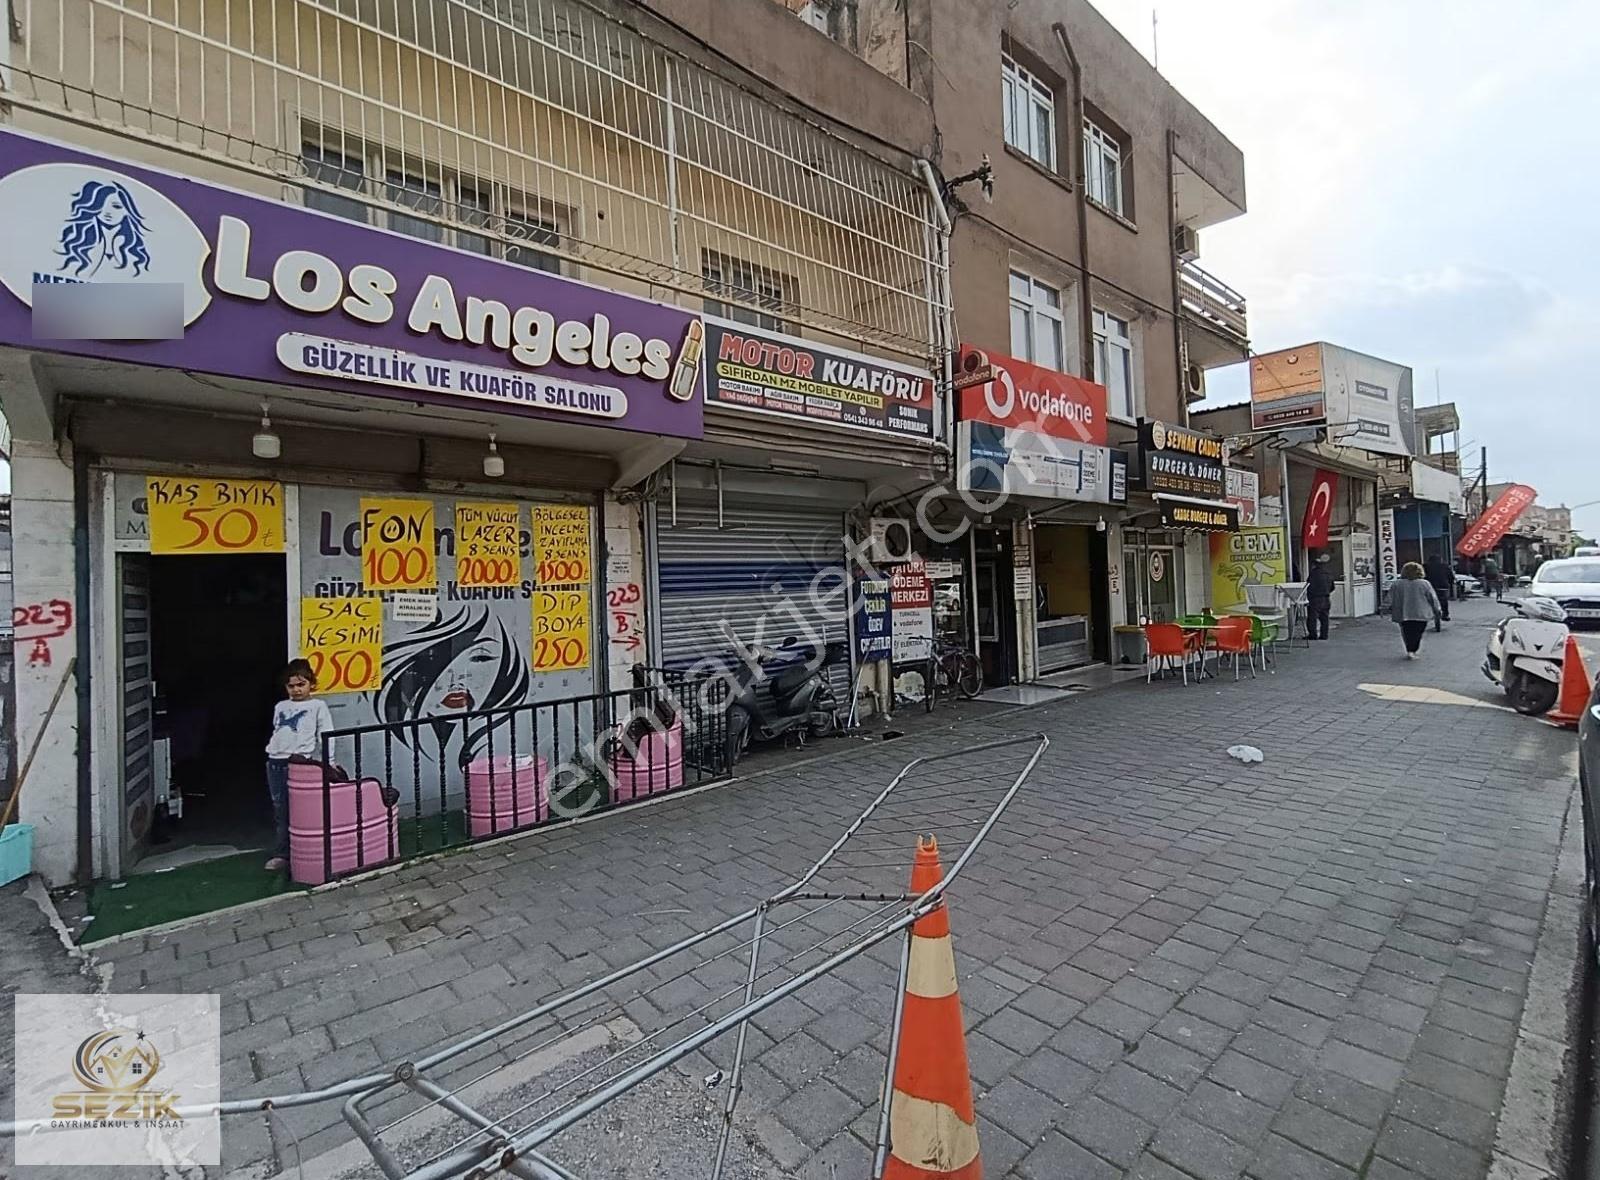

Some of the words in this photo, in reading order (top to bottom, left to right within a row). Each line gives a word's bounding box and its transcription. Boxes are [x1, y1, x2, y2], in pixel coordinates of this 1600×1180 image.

[214, 214, 397, 324] Los
[408, 275, 672, 381] Angeles
[302, 343, 416, 383] GÜZELLİK
[425, 365, 451, 389] VE
[460, 371, 537, 402] KUAFÖR
[544, 386, 612, 413] SALONU
[719, 333, 815, 379] MOTOR
[822, 359, 923, 402] KUAFÖRÜ
[954, 371, 990, 386] vodafone
[721, 364, 778, 386] SIFIRDAN
[780, 377, 797, 390] MZ
[843, 390, 880, 406] YAPILIR
[1018, 389, 1093, 424] vodafone
[1198, 438, 1221, 458] CADDE
[1152, 456, 1187, 475] BURGER
[1188, 462, 1196, 477] &
[1197, 463, 1222, 481] DÖNER
[150, 480, 200, 506] KAŞ
[212, 482, 275, 507] BIYIK
[457, 508, 482, 524] TÜM
[533, 507, 585, 521] BÖLGESEL
[173, 508, 258, 549] 50
[461, 525, 516, 544] LAZER
[1382, 520, 1392, 543] RENT
[482, 545, 516, 556] SEANS
[1230, 532, 1281, 552] CEM
[364, 546, 428, 585] 100
[458, 557, 513, 585] 2000
[537, 560, 583, 584] 1500
[1383, 555, 1394, 574] CAR
[893, 575, 925, 588] ÖDEME
[543, 592, 581, 613] DİP
[607, 583, 640, 607] 229
[307, 601, 372, 620] SAÇ
[535, 616, 586, 635] BOYA
[615, 615, 628, 634] B
[29, 639, 51, 665] A
[534, 636, 583, 668] 250
